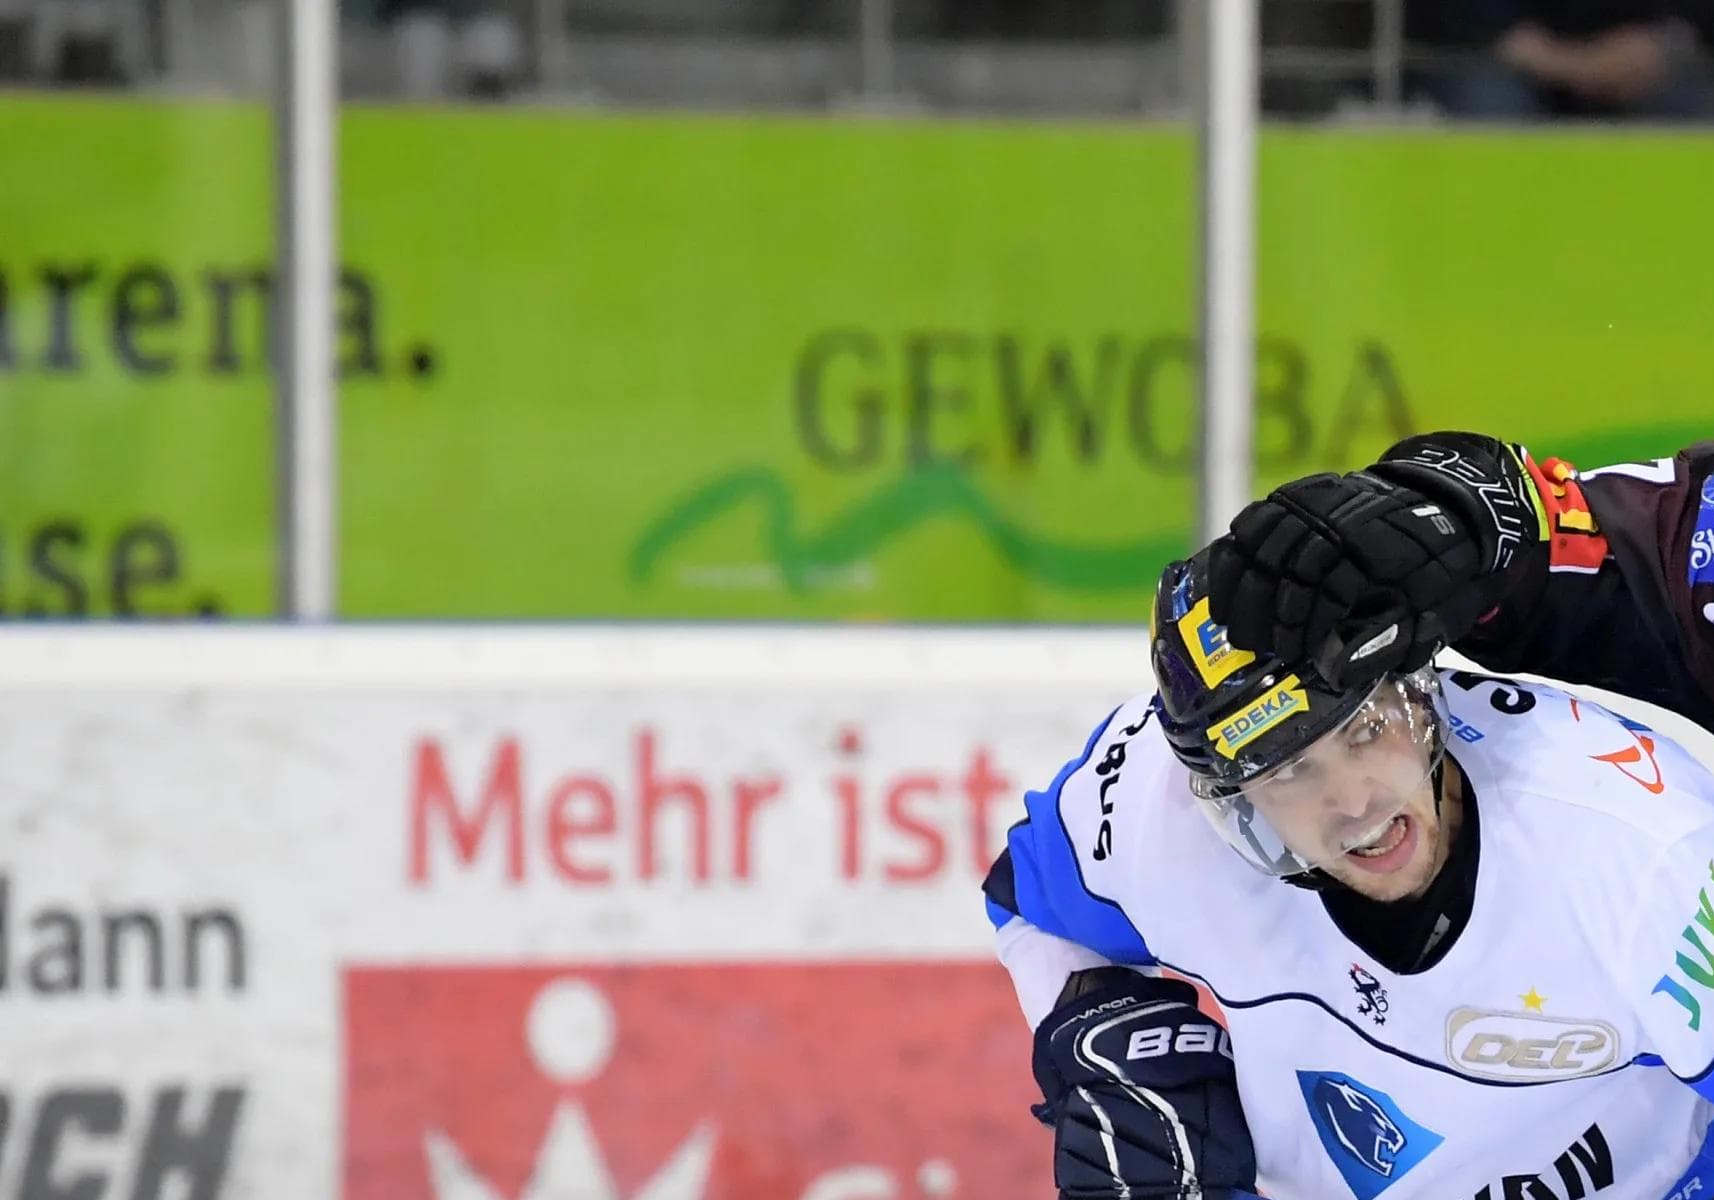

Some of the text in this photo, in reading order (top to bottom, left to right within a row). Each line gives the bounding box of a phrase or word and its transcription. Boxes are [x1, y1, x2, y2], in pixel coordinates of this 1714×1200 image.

[0, 257, 442, 381] rena.
[793, 327, 1424, 477] GEWOBA
[0, 518, 226, 622] se.
[1220, 688, 1297, 744] EDEKA
[404, 722, 1015, 889] Mehr ist
